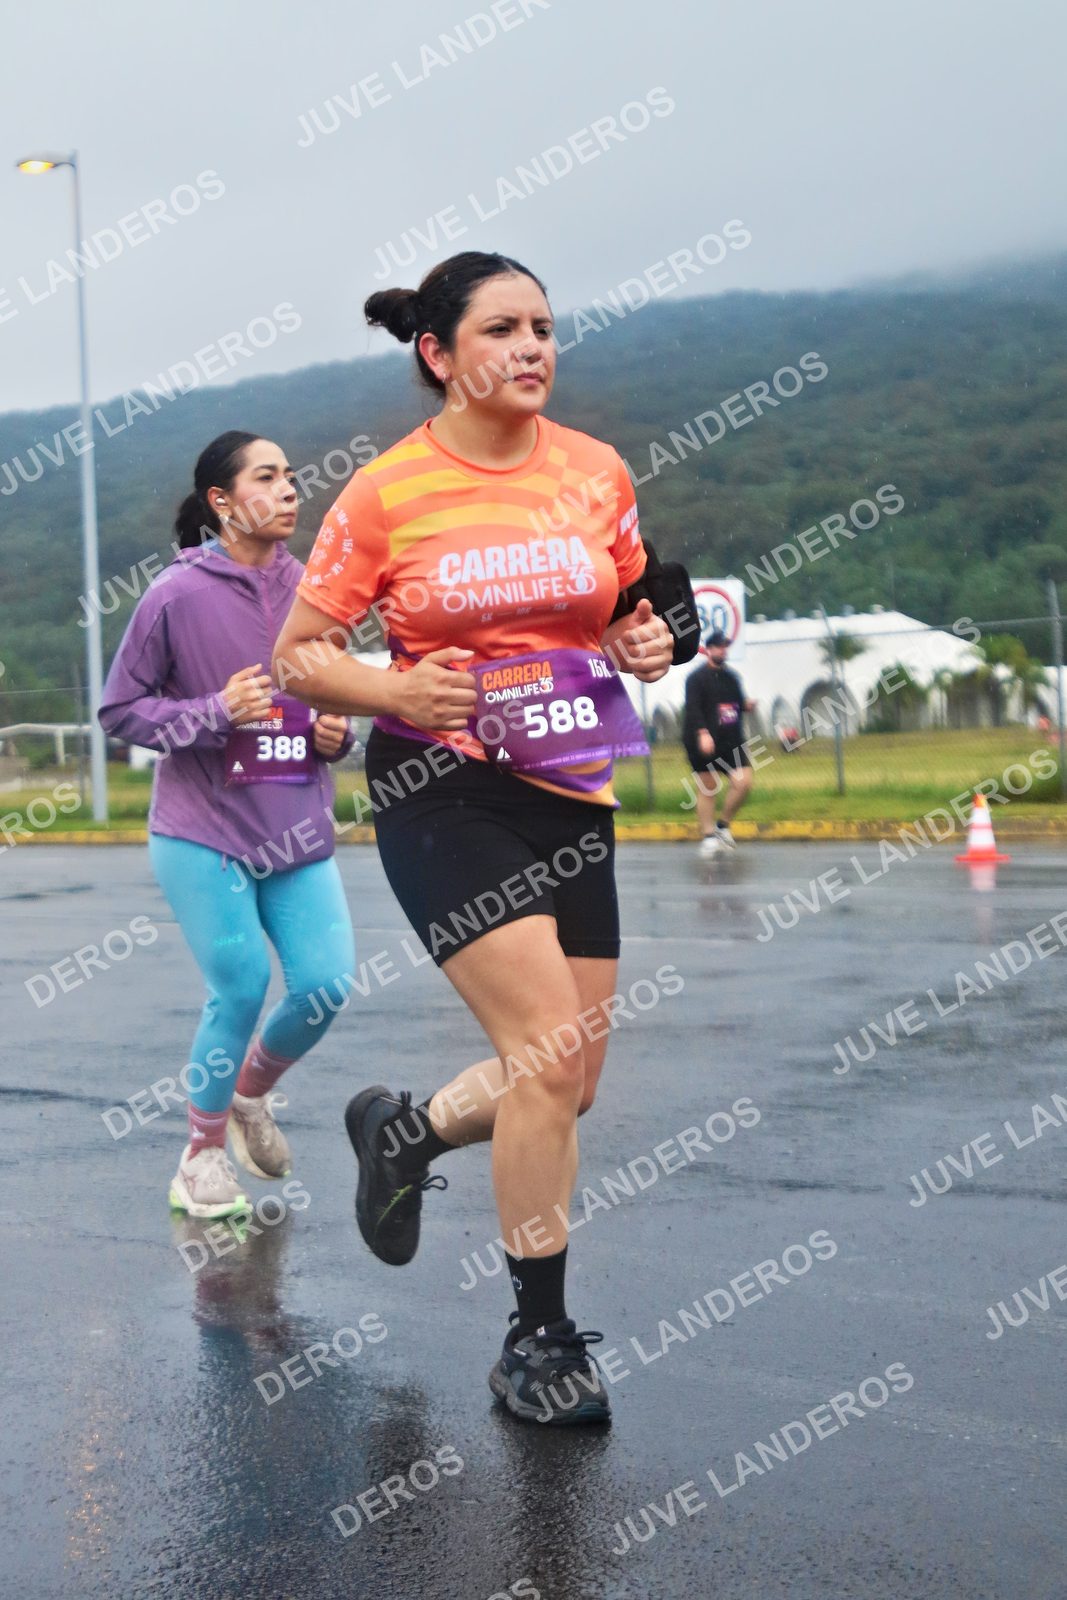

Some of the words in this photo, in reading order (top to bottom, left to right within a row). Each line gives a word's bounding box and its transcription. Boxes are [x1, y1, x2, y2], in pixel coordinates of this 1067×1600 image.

[439, 536, 593, 587] CARRERA
[442, 576, 566, 613] OMNILIFE
[482, 661, 553, 691] CARRERA
[588, 658, 613, 678] 15K
[485, 683, 540, 704] OMNILIFE
[523, 696, 599, 739] 588
[256, 735, 307, 761] 388
